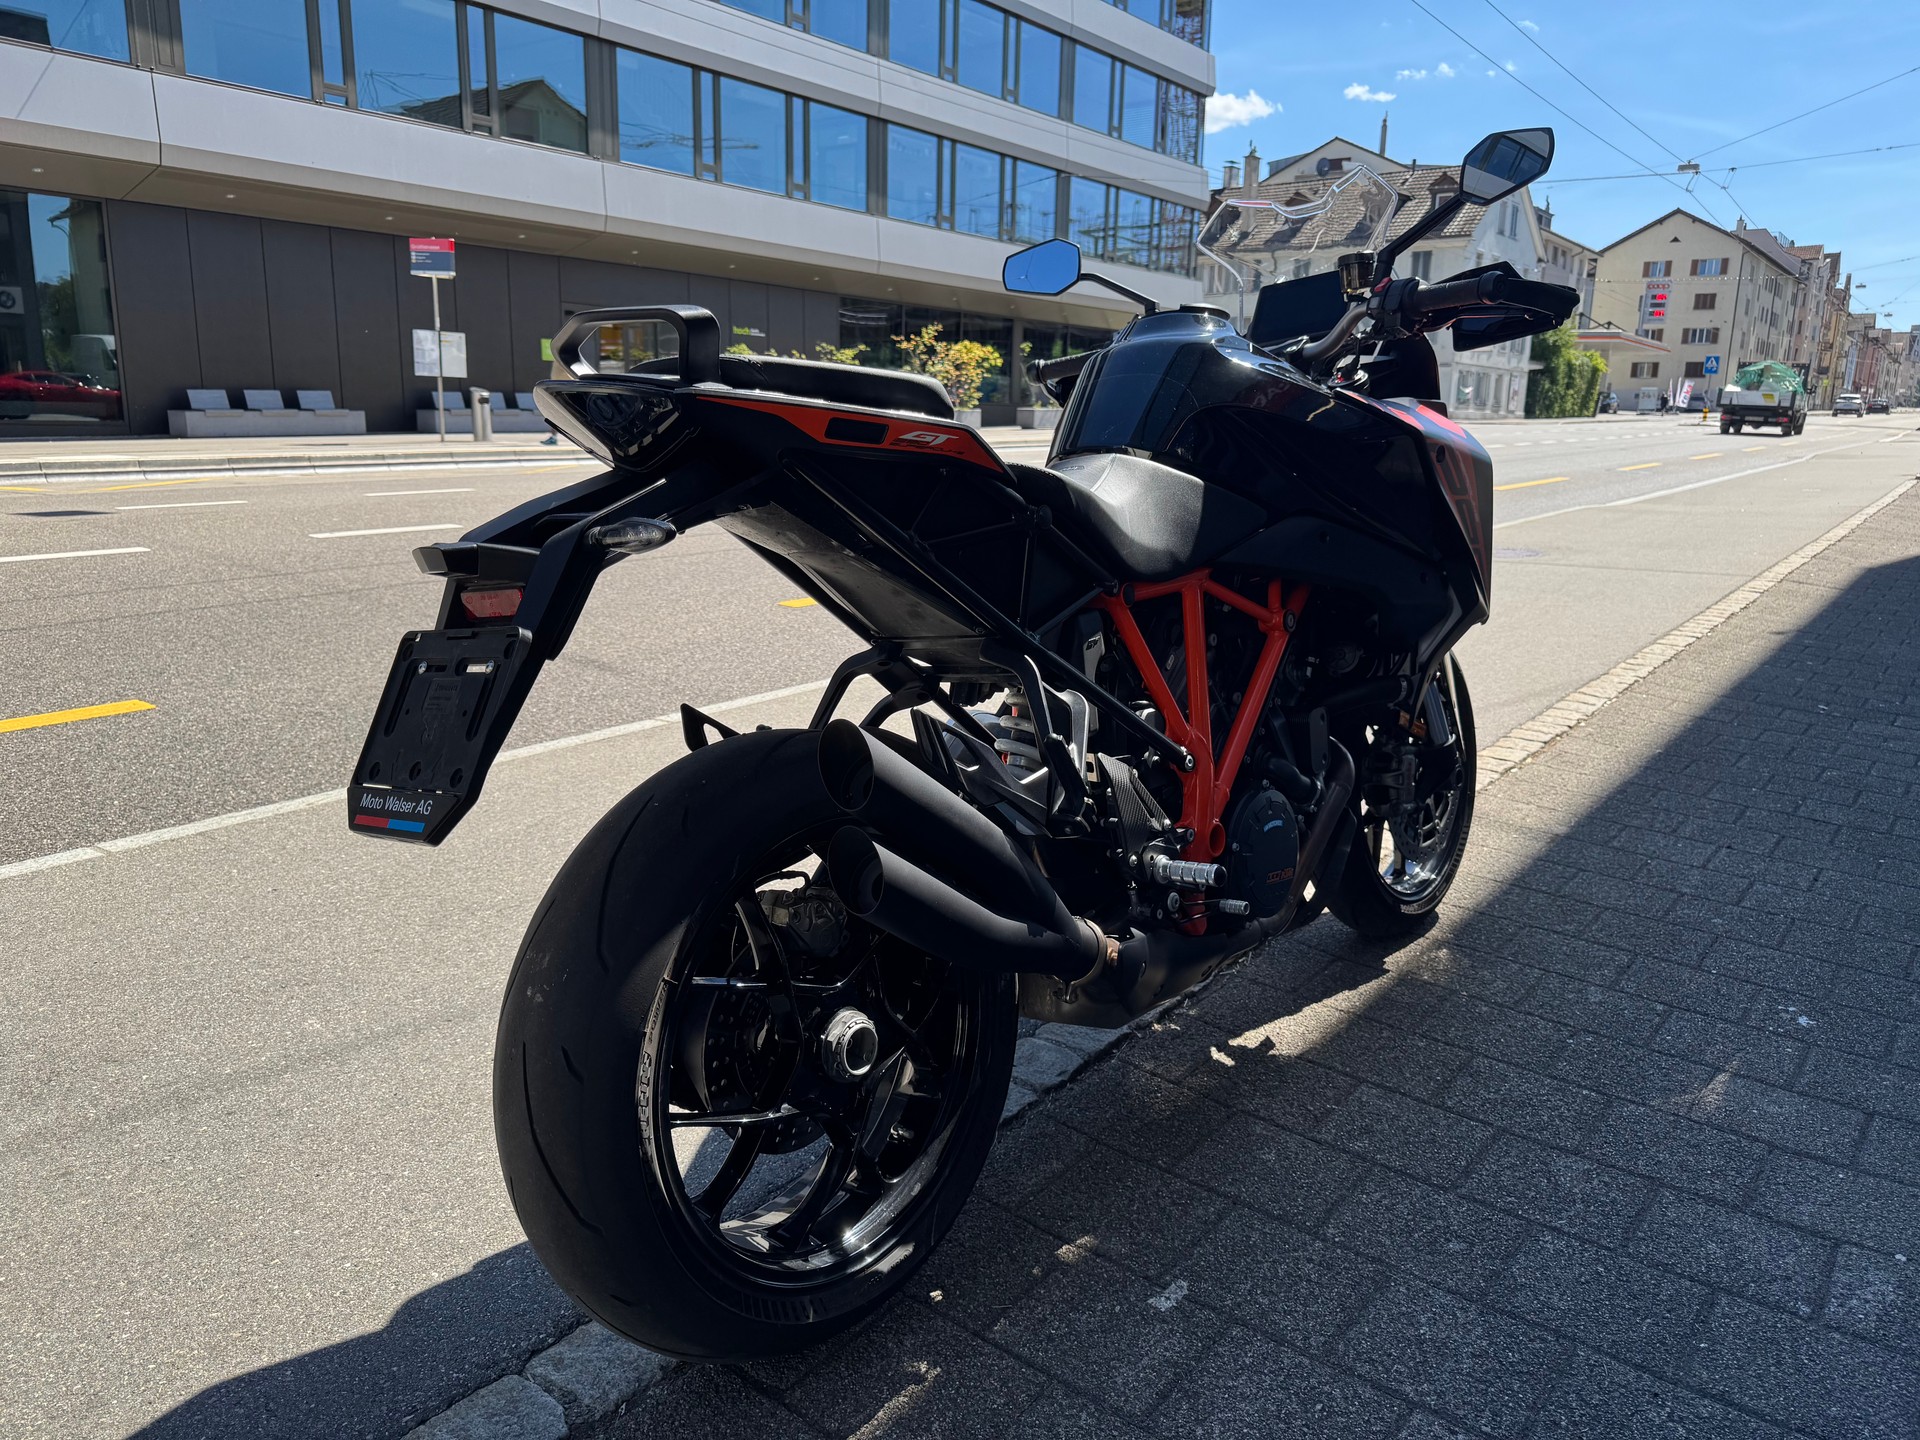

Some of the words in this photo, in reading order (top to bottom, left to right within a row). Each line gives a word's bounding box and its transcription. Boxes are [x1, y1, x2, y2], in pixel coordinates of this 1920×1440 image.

[899, 430, 960, 446] GT
[360, 793, 383, 810] Moto
[384, 795, 416, 813] Walser
[415, 799, 433, 815] AG
